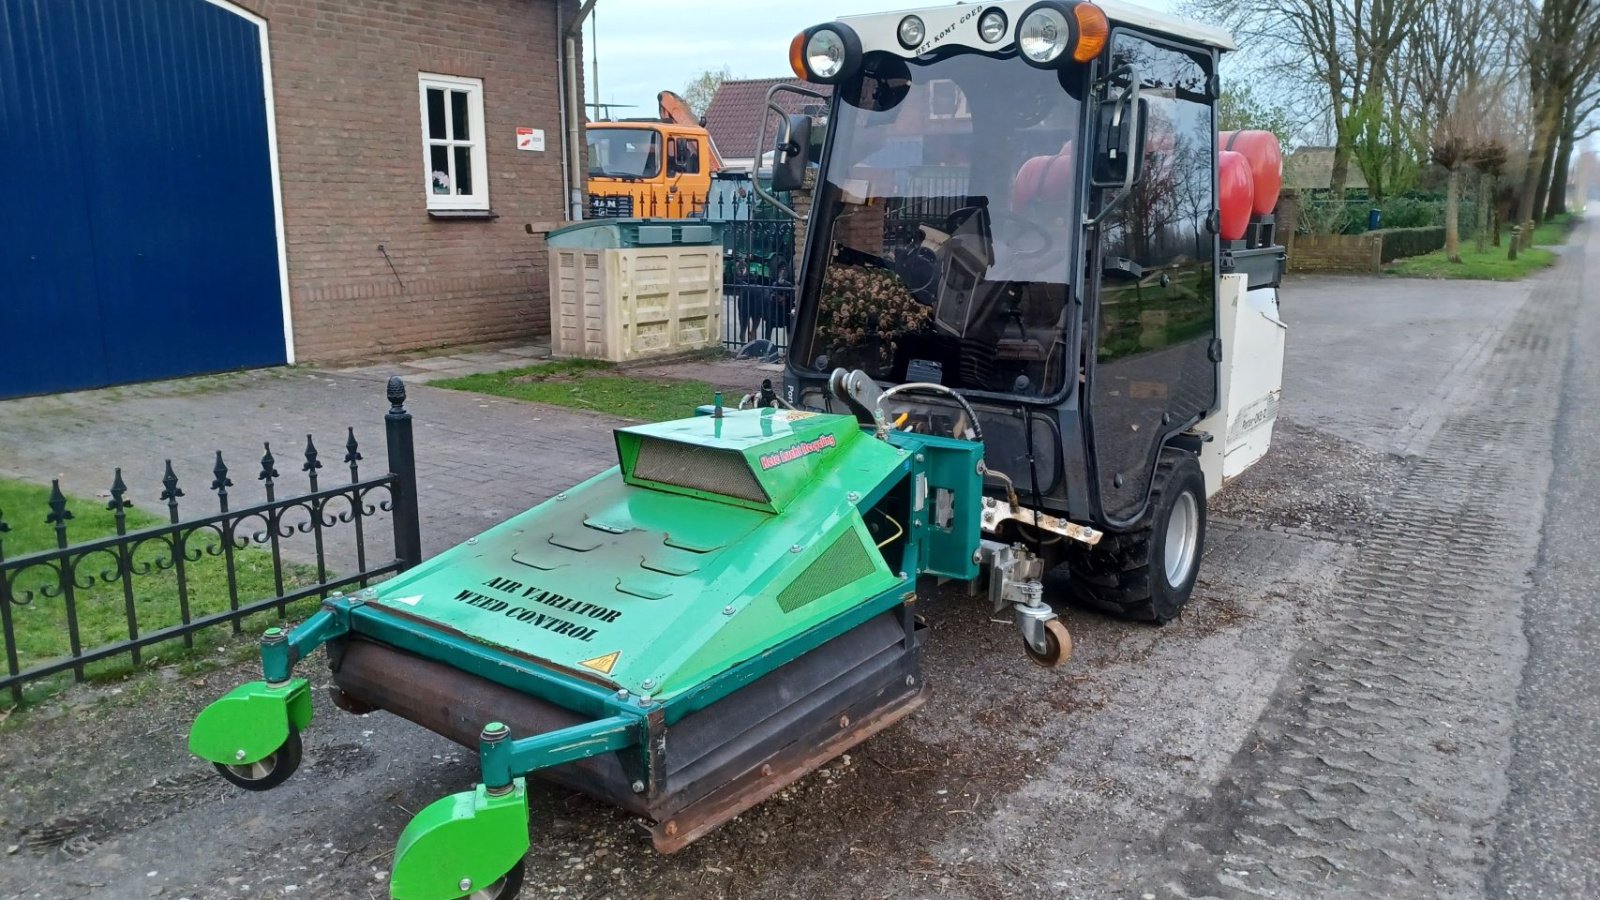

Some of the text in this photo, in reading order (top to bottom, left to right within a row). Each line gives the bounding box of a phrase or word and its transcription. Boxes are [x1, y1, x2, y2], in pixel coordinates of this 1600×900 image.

[915, 5, 983, 56] HET KOMT GOED
[802, 433, 836, 455] Recycling
[454, 589, 599, 642] WEED CONTROL
[482, 576, 622, 623] AIR VARIATOR
